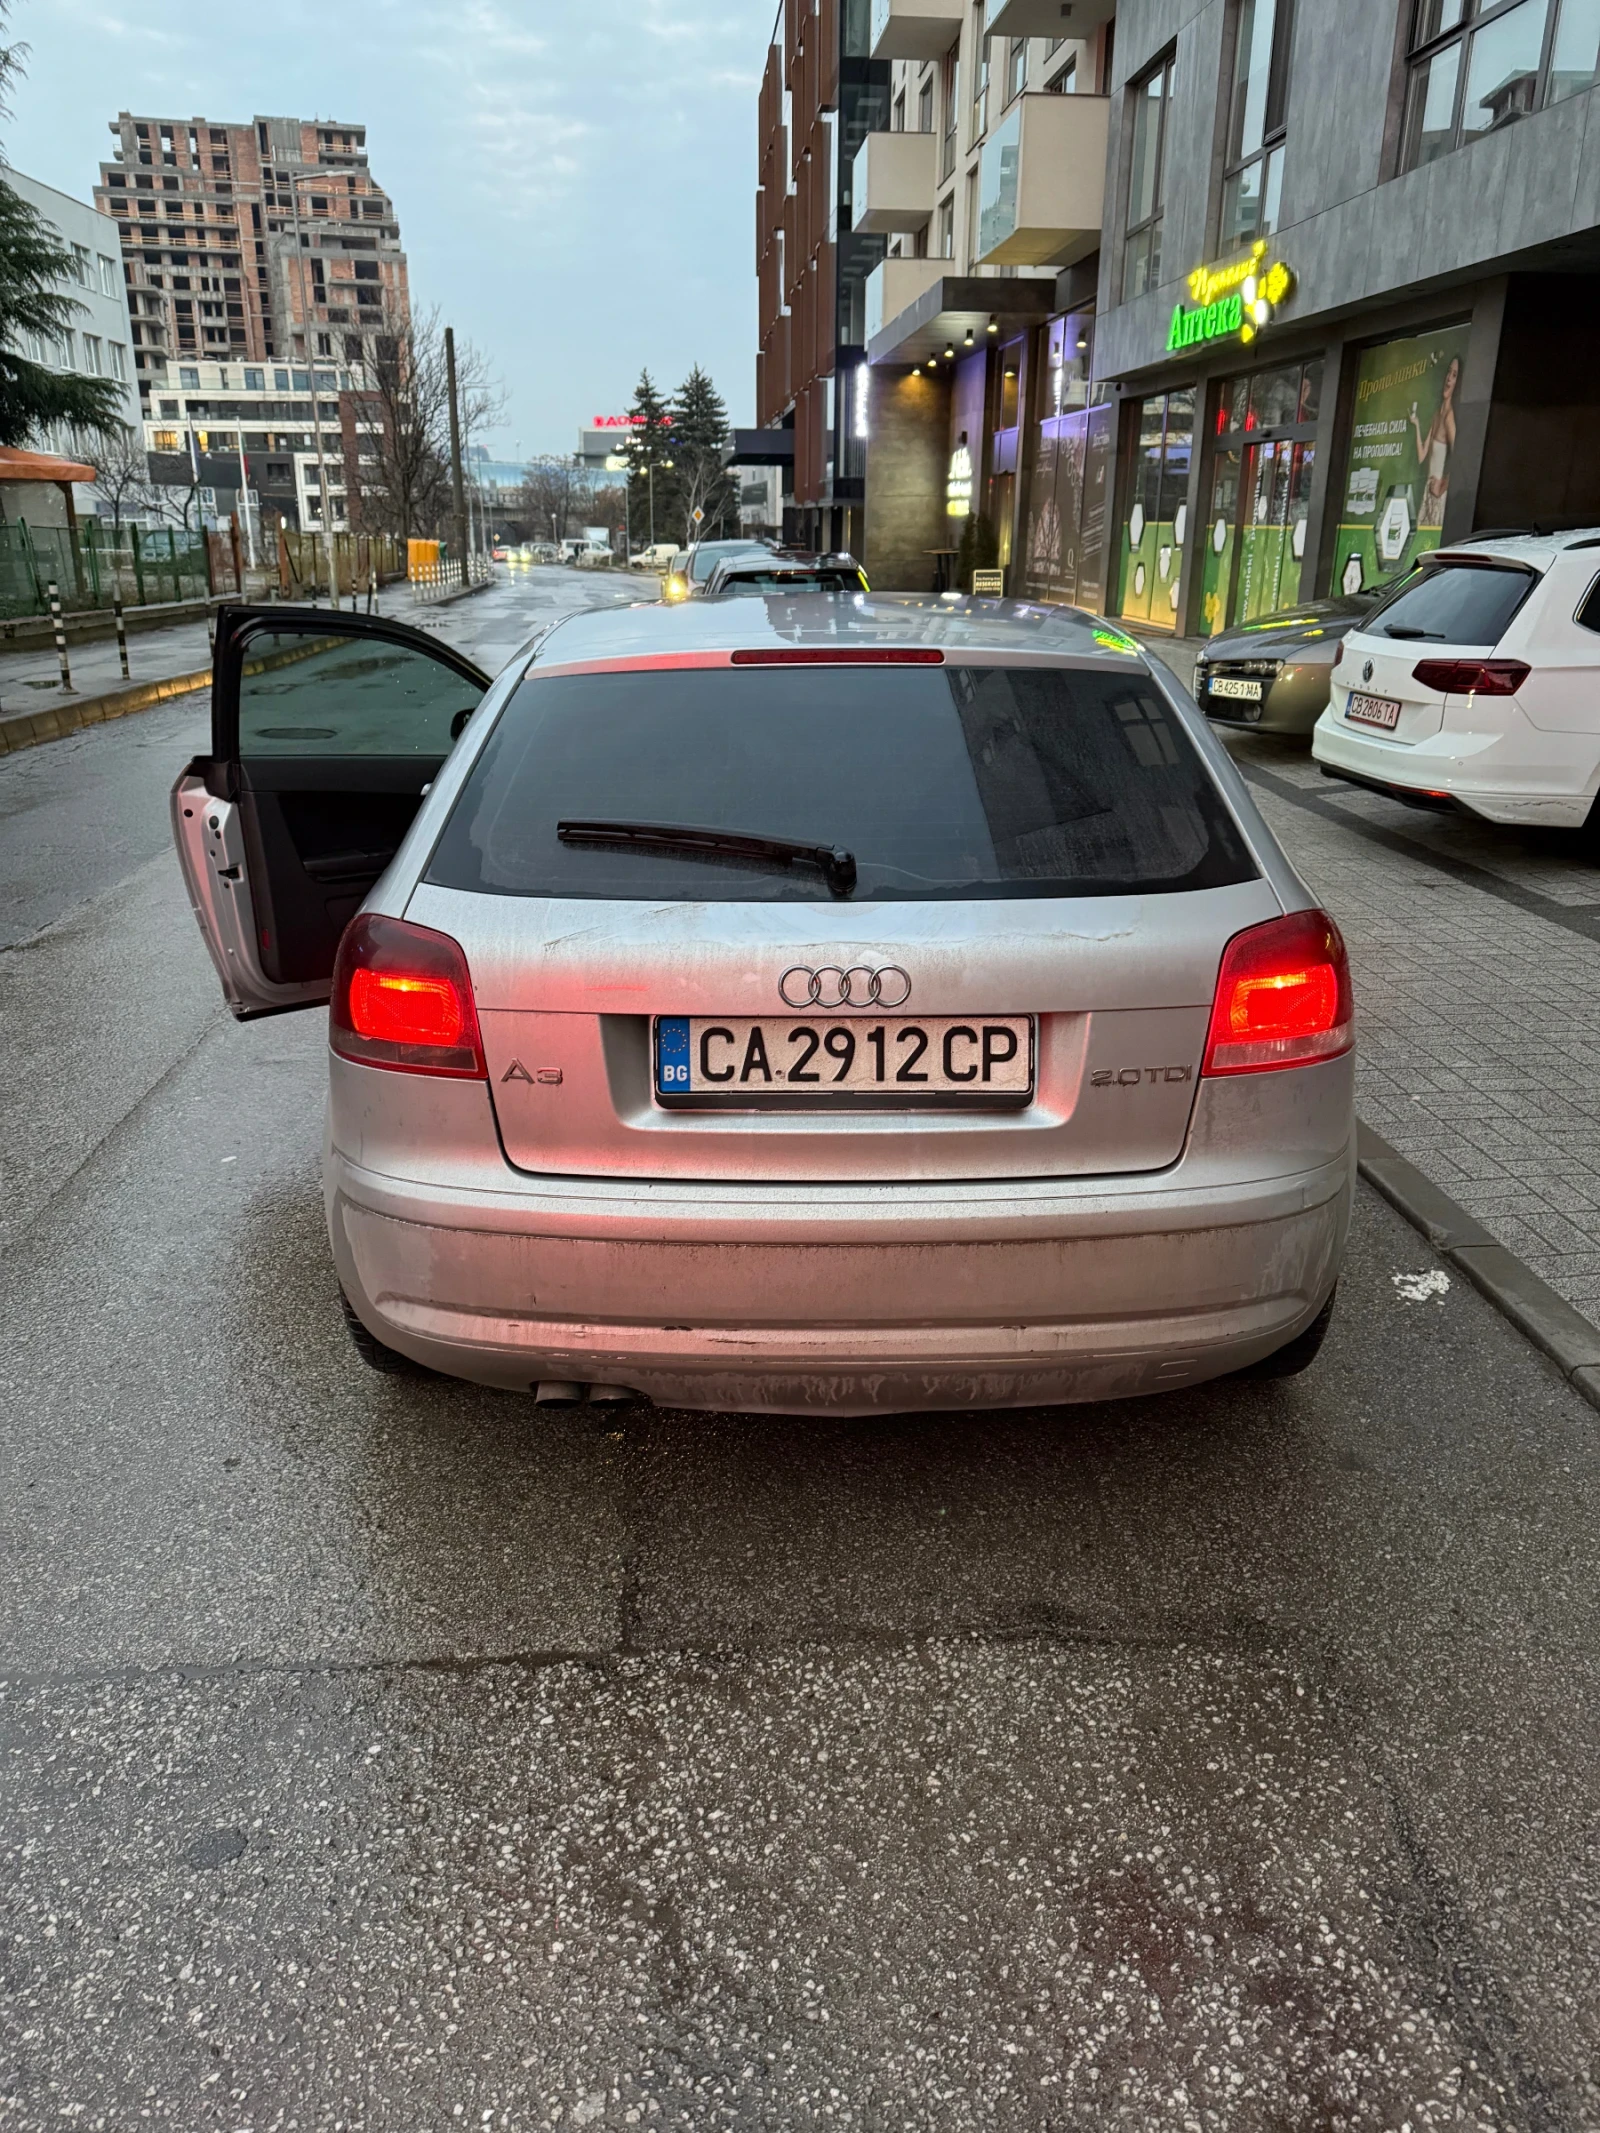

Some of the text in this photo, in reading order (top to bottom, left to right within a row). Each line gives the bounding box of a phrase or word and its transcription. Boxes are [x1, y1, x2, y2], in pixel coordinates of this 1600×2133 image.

[1166, 293, 1242, 351] Аптека
[1359, 359, 1427, 402] Прополинки
[1389, 419, 1407, 435] СИЛА
[1353, 446, 1362, 459] НА
[1224, 681, 1245, 695] 4251
[1246, 683, 1259, 697] MA
[1362, 699, 1383, 720] 2806
[1383, 704, 1395, 724] TA
[700, 1026, 1018, 1083] CA 2912 CP
[500, 1058, 563, 1086] A3
[663, 1065, 688, 1082] BG
[1144, 1064, 1192, 1083] TDI
